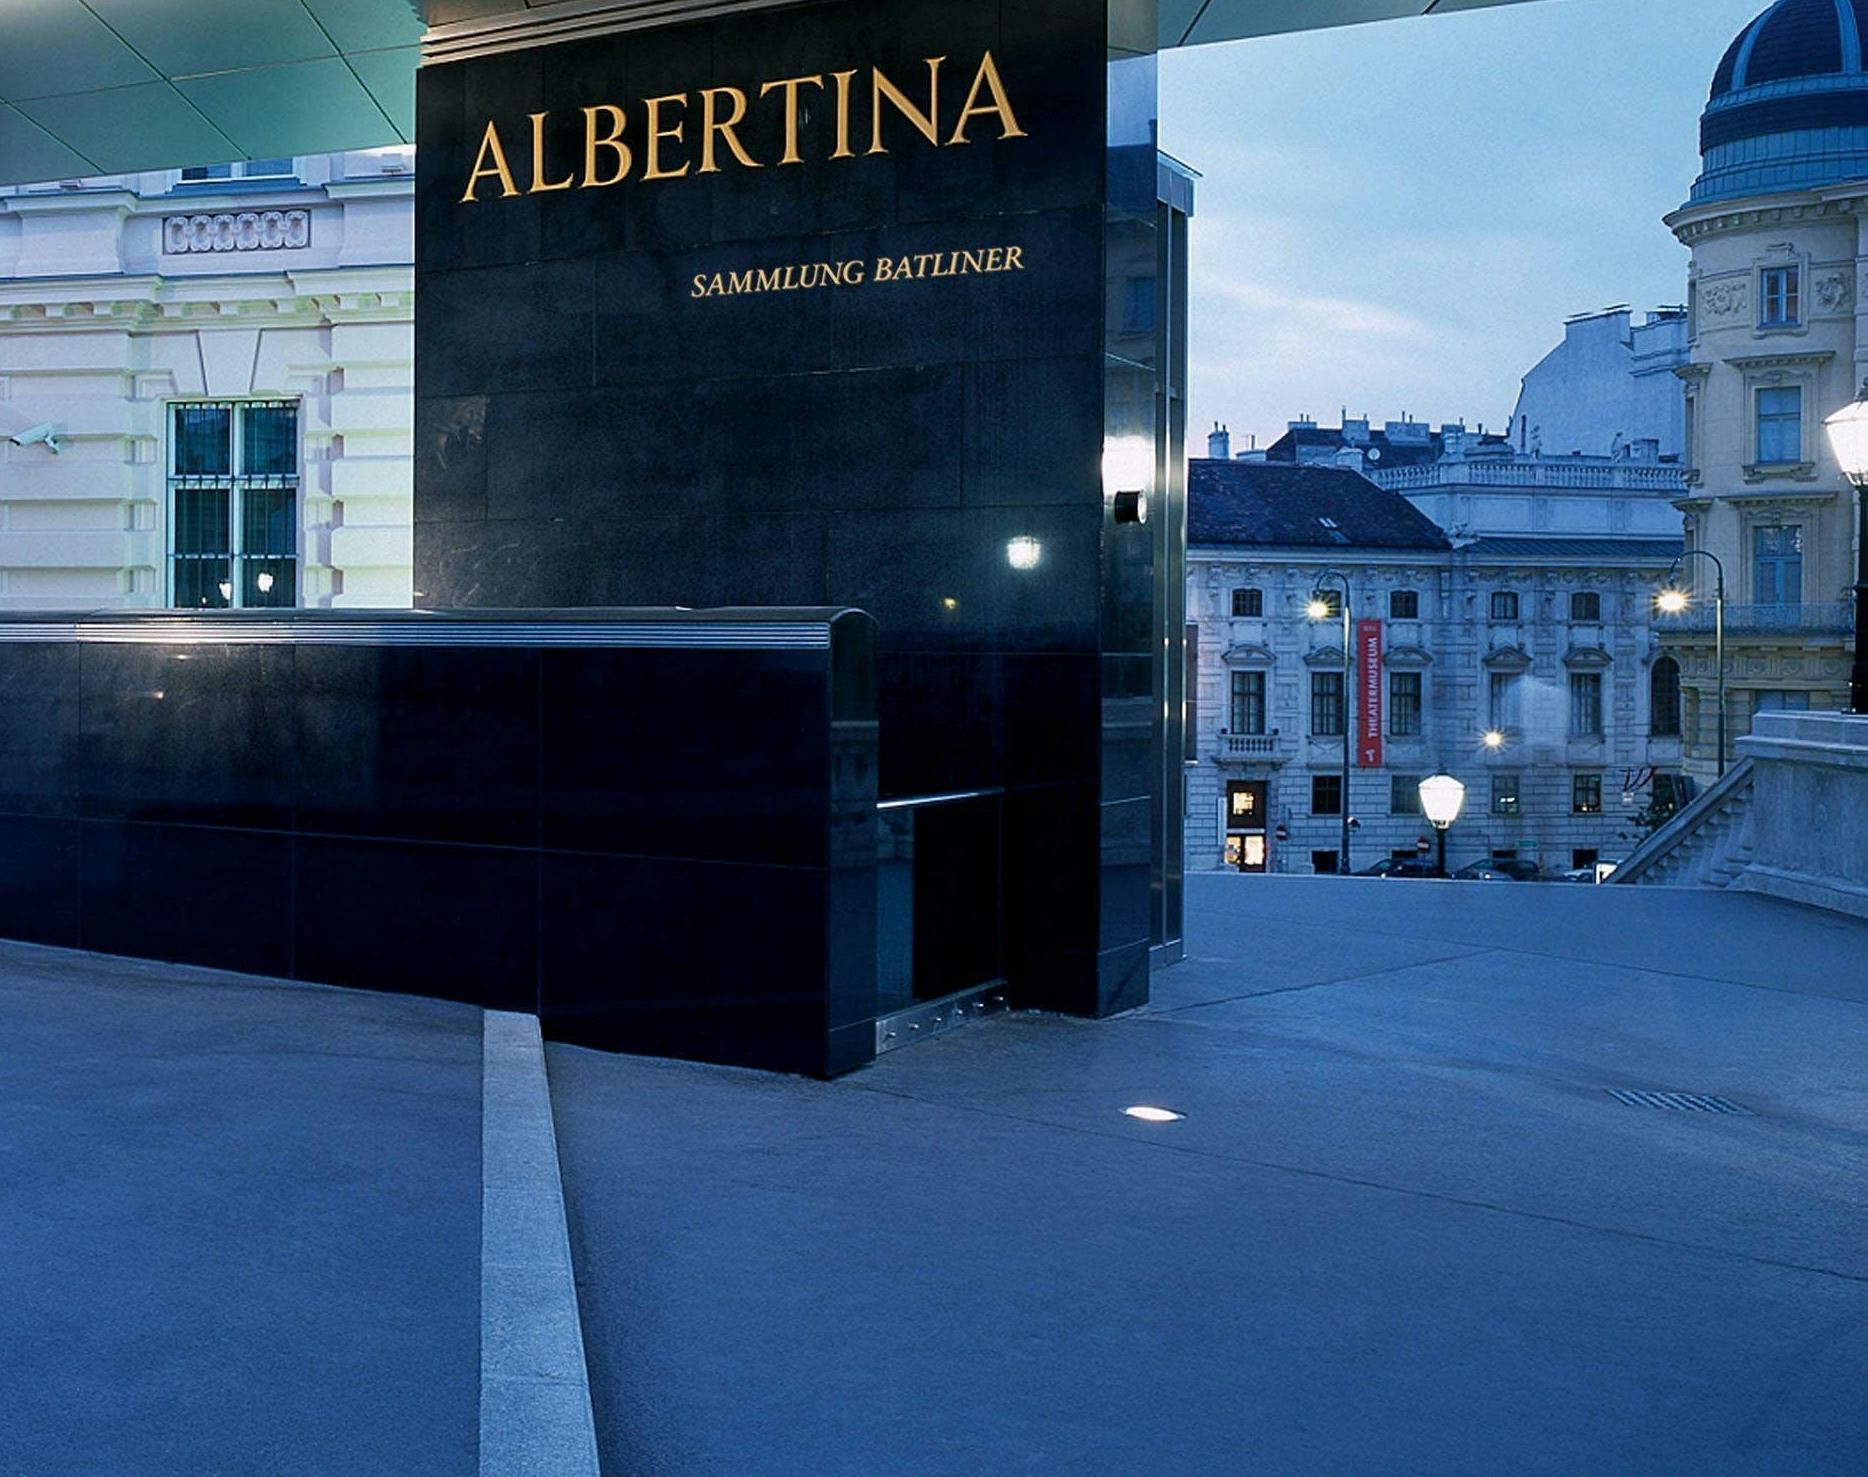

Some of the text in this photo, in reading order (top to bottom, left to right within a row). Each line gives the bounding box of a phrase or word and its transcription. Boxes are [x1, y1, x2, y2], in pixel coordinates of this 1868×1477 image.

[460, 50, 1028, 203] ALBERTINA
[691, 246, 1025, 298] SAMMLUNG BATLINER
[1368, 637, 1378, 738] THEATERMUSEUM
